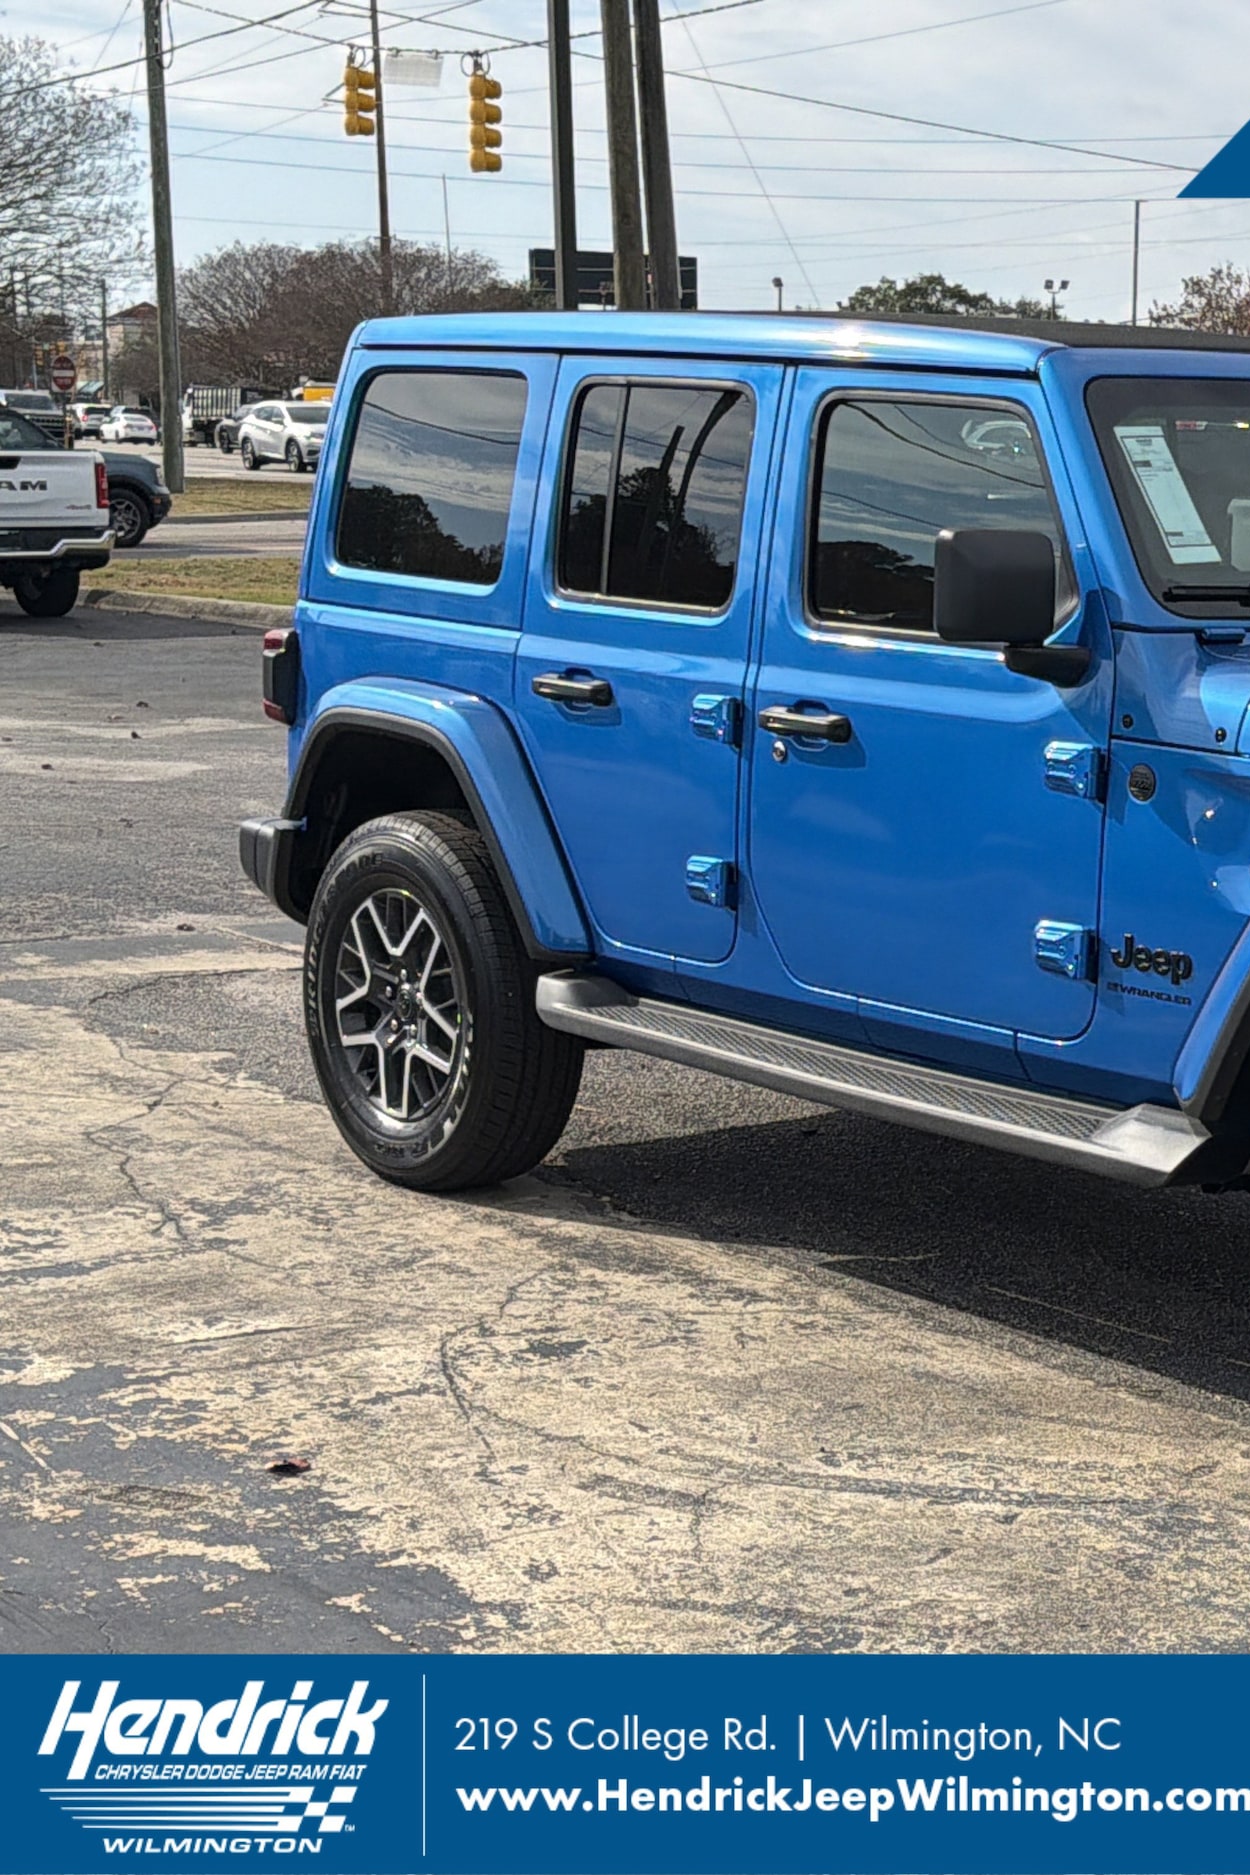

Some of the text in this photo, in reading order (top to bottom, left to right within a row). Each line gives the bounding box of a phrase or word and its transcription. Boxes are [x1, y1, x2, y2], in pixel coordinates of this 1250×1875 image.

[0, 480, 48, 491] AM
[1110, 932, 1193, 986] Jeep
[1119, 983, 1192, 1006] WRANGLER
